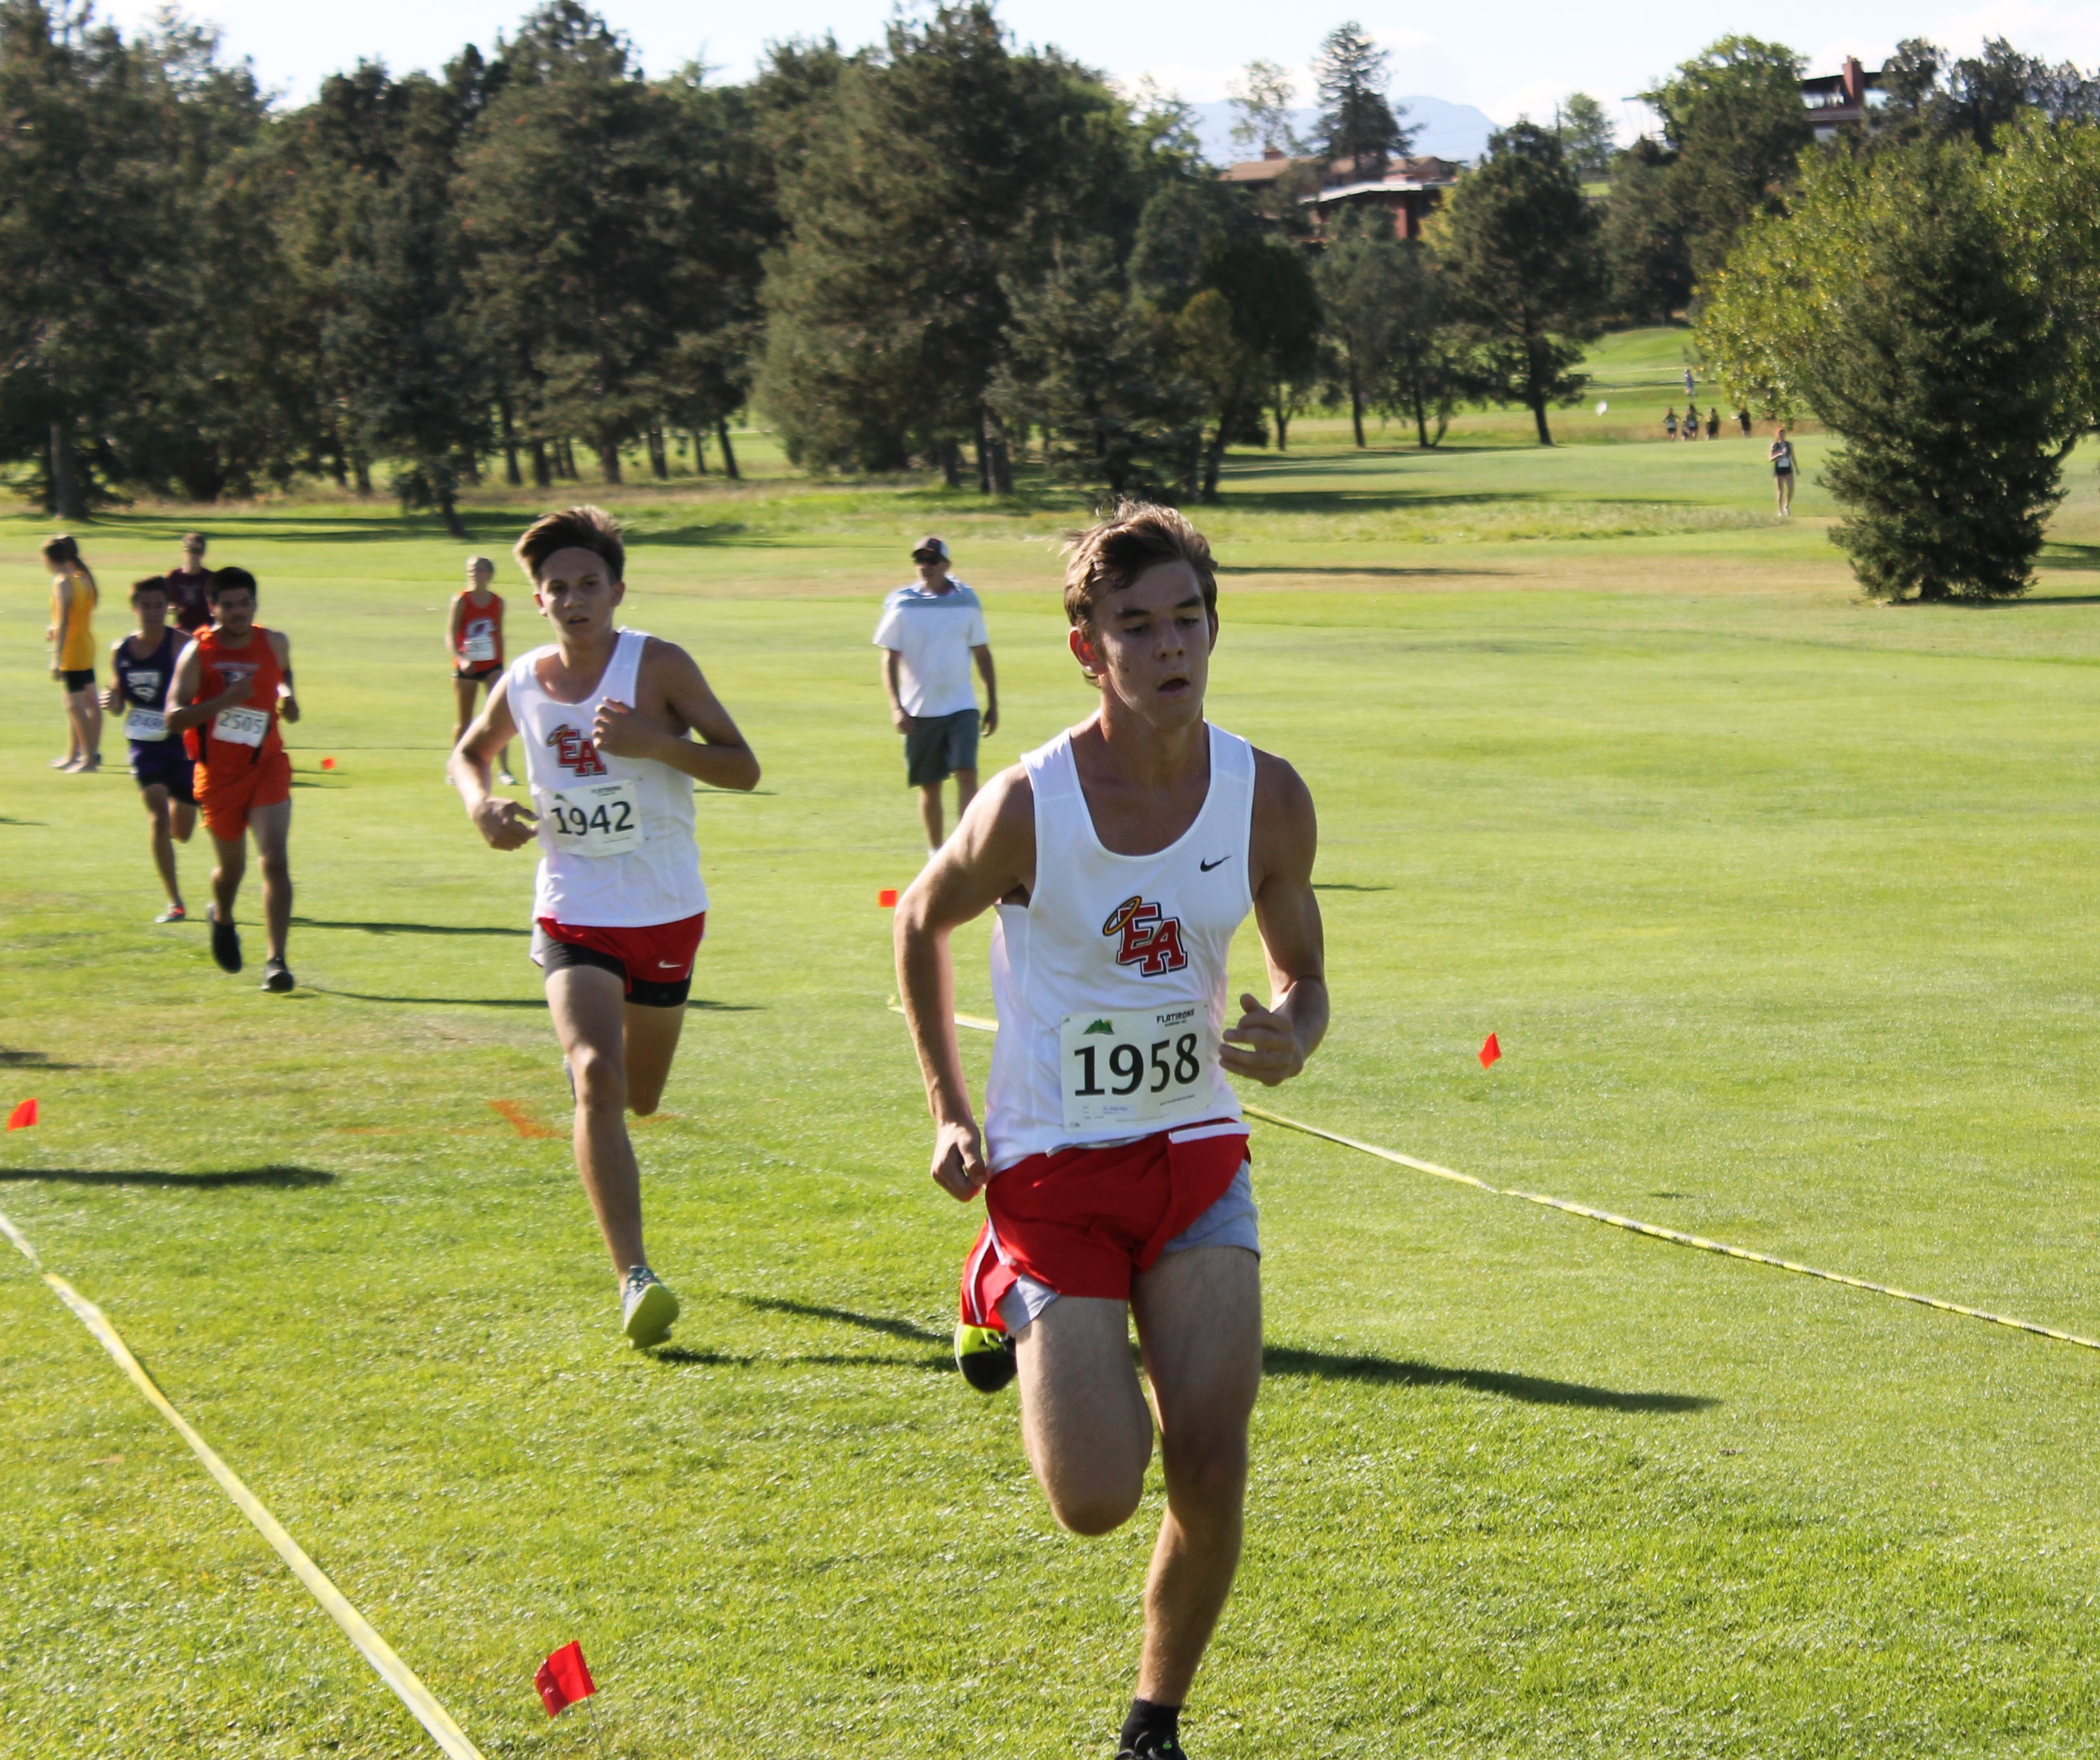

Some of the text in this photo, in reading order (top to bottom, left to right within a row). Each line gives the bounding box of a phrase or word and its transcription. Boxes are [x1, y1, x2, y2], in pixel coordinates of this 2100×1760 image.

[556, 729, 608, 777] EA
[550, 800, 634, 836] 1942
[1116, 902, 1188, 978] EA
[1156, 1009, 1195, 1024] FLATIRONS
[1074, 1032, 1200, 1096] 1958
